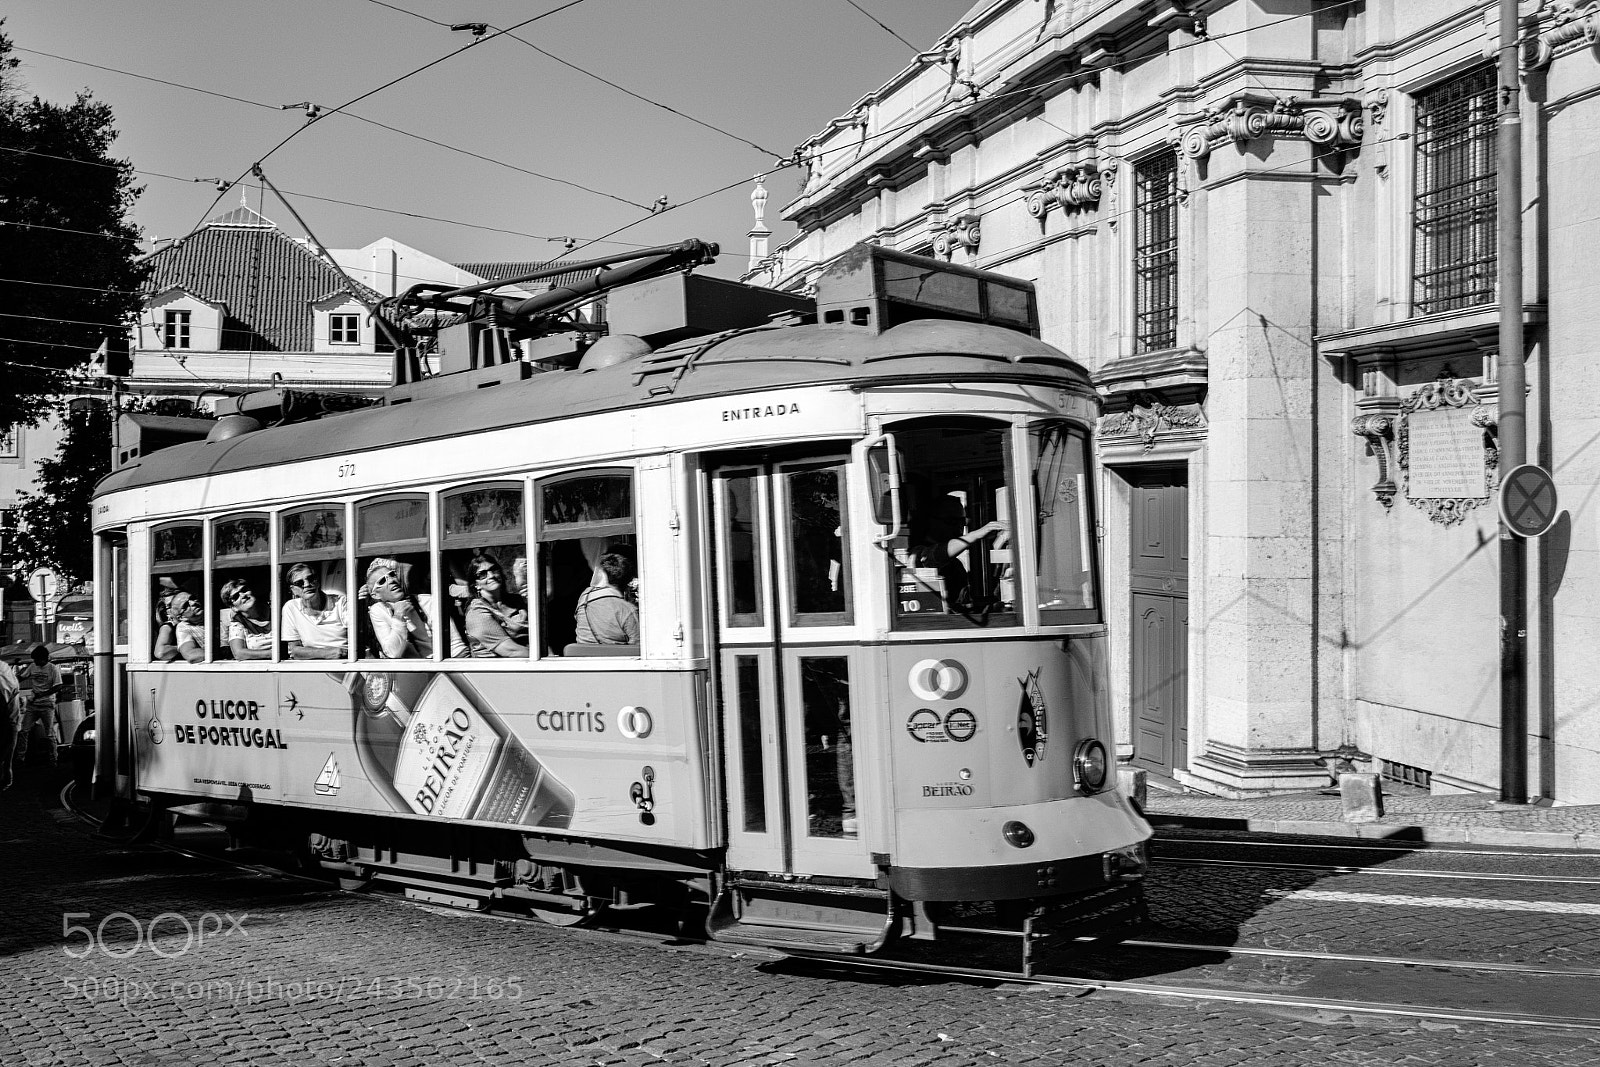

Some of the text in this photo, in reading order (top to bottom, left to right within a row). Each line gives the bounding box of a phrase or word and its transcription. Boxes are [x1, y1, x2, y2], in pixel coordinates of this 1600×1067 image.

[721, 402, 802, 422] ENTRADA
[338, 463, 356, 478] 572
[195, 699, 260, 721] O LICOR
[535, 702, 606, 733] carris
[174, 724, 288, 750] DE PORTUGAL
[414, 707, 470, 815] BEIRÃO
[451, 775, 459, 786] DE
[456, 734, 477, 774] PORTUGAL
[921, 783, 973, 797] BEIRÃO
